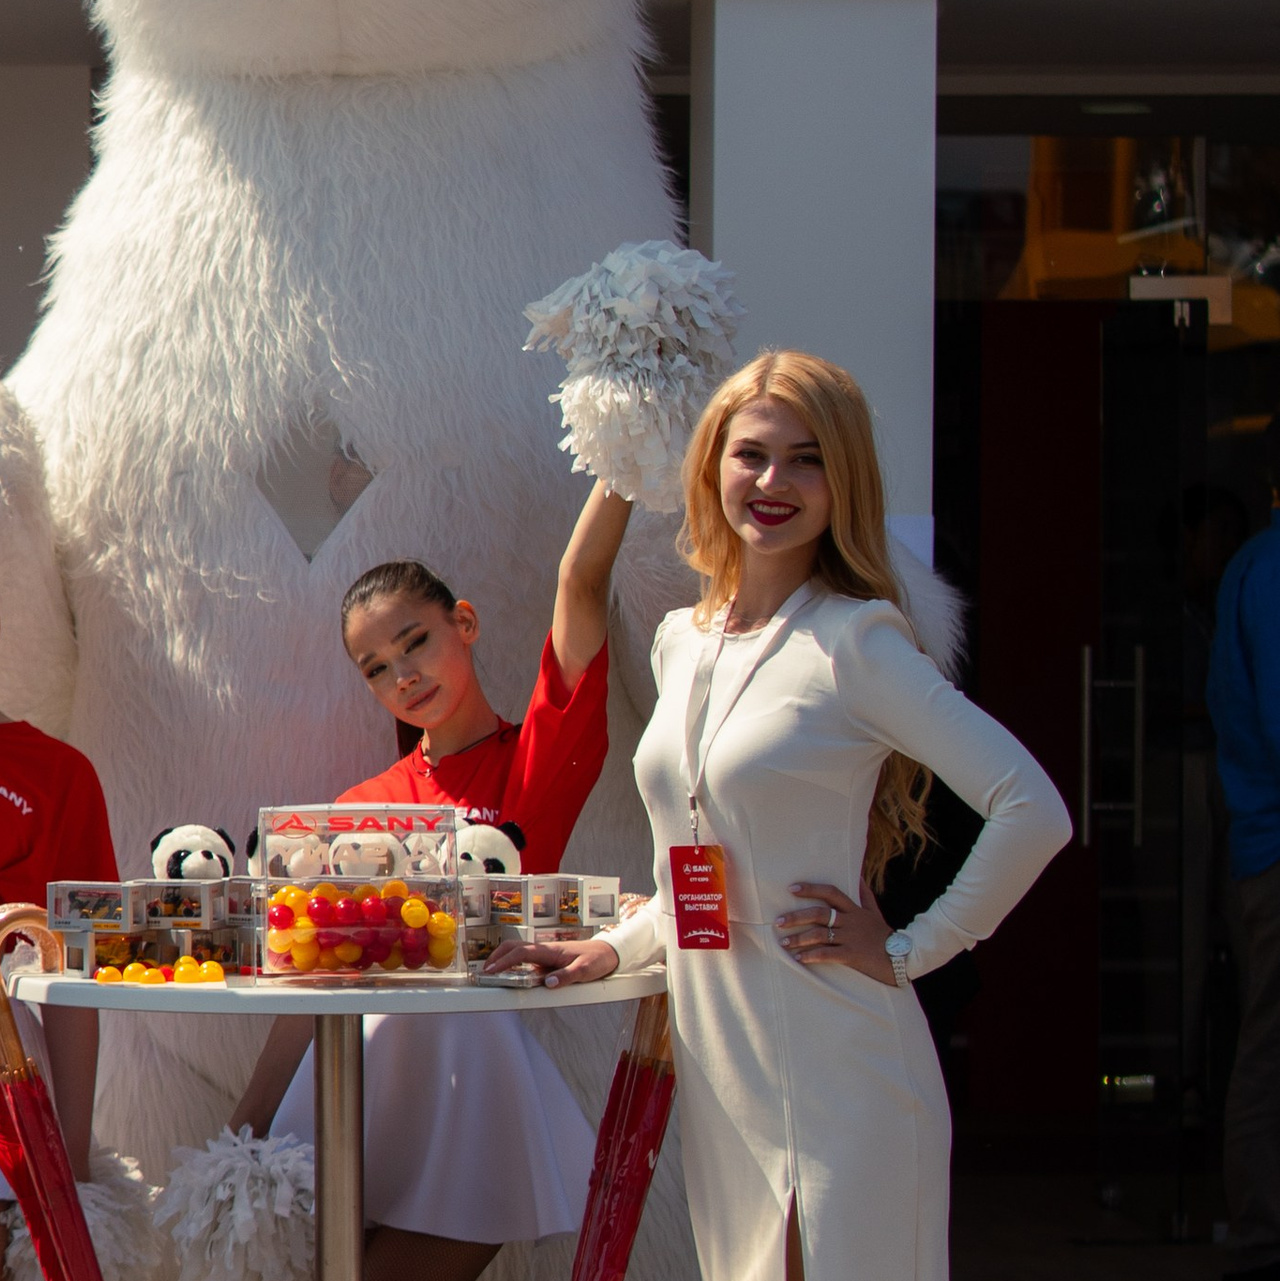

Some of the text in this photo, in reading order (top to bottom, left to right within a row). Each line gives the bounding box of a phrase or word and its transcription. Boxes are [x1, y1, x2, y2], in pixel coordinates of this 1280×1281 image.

[328, 816, 444, 832] SANY
[692, 864, 713, 873] SANY
[679, 893, 723, 902] ОРГАНИЗАТОР
[685, 903, 718, 911] ВЫСТАВКИ
